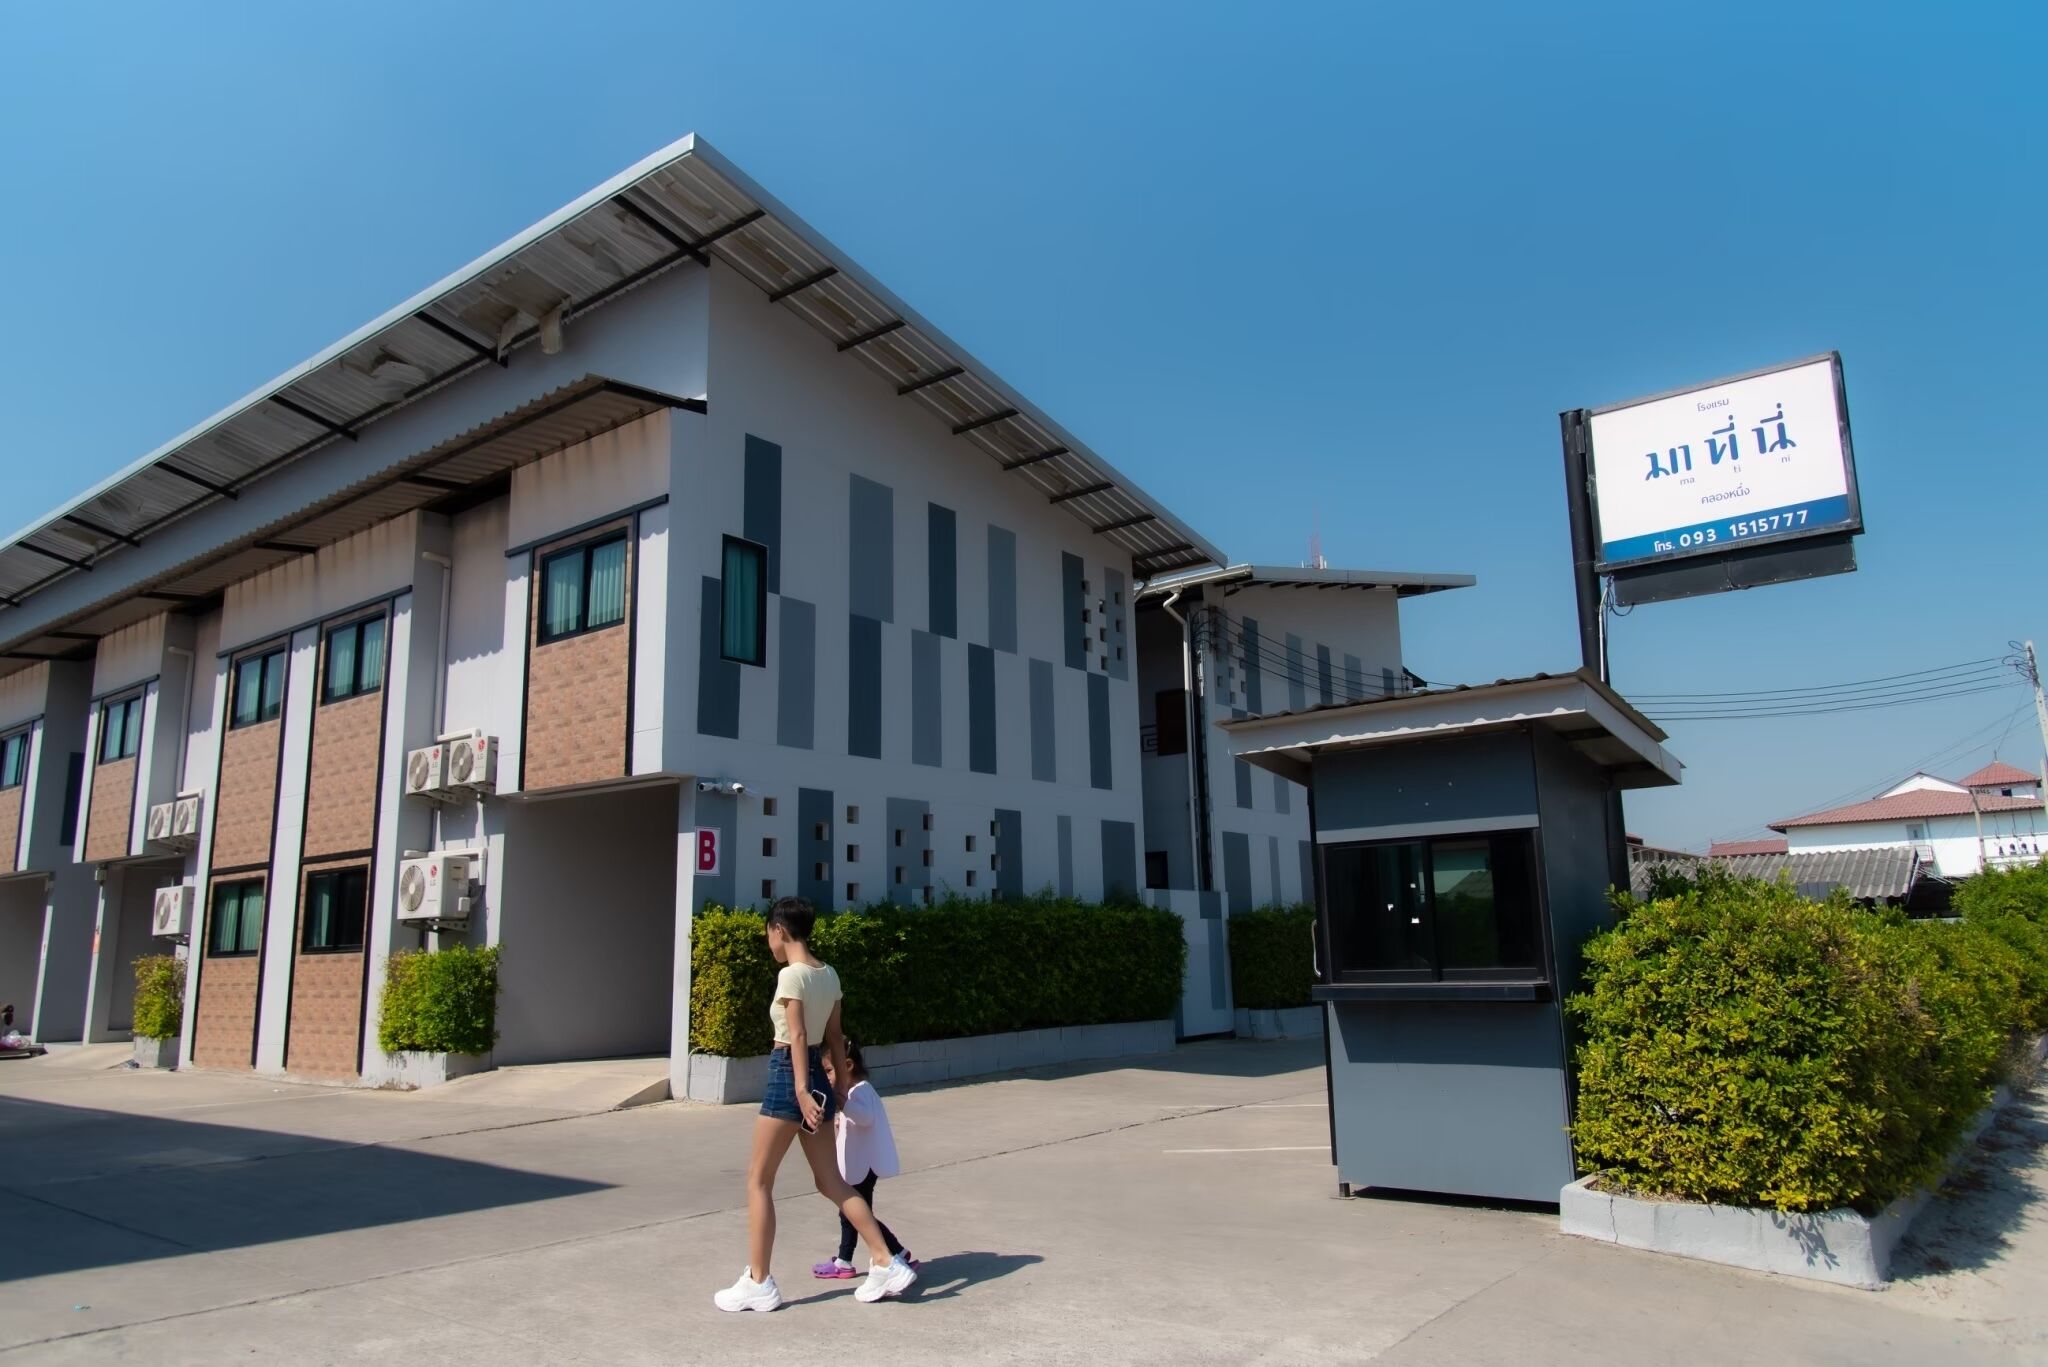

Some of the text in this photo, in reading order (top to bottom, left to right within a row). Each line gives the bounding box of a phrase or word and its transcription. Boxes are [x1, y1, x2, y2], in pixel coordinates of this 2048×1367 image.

[1679, 454, 1791, 486] ma ti ni
[1701, 483, 1750, 504] คลองหนึ่ง
[1680, 529, 1717, 547] 093
[1729, 510, 1808, 537] 1515777
[698, 830, 716, 871] B
